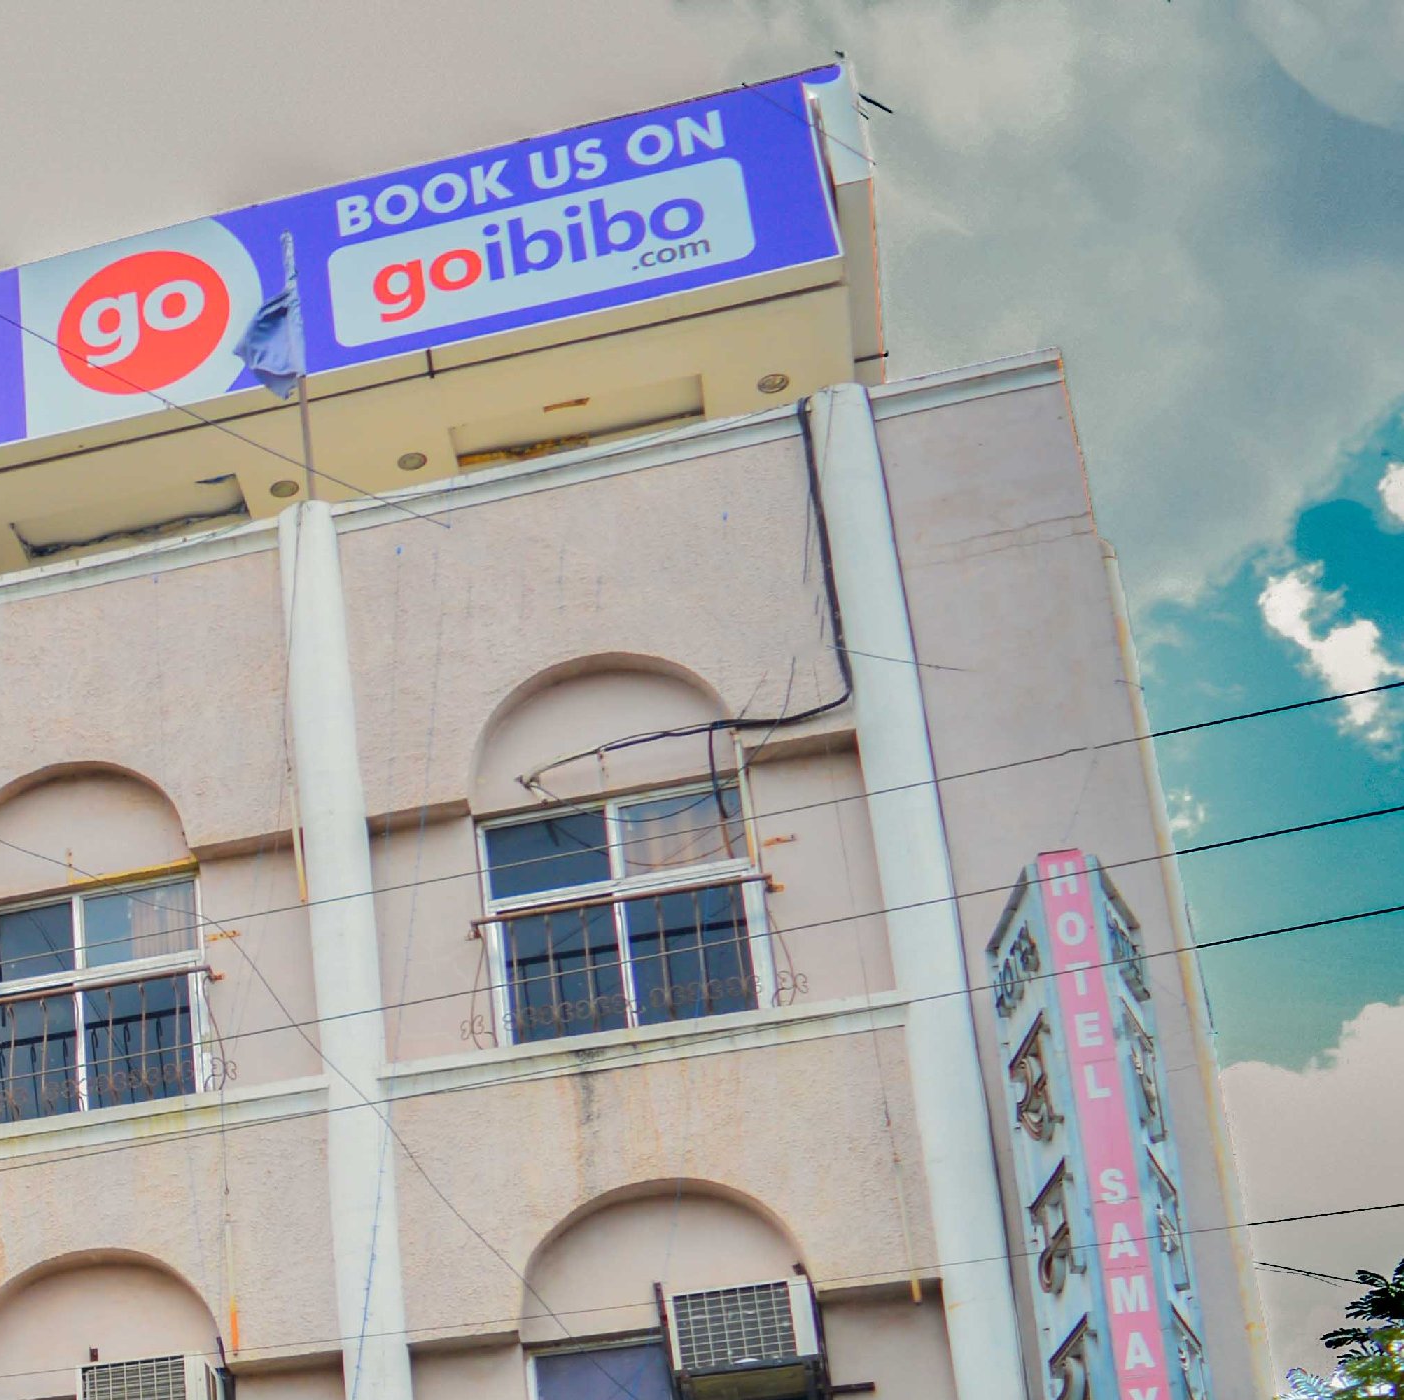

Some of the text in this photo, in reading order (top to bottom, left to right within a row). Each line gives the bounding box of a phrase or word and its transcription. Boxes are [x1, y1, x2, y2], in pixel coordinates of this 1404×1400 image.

[335, 108, 727, 239] BOOK US ON
[371, 194, 705, 323] goibibo
[631, 235, 712, 272] .com
[79, 269, 204, 370] go
[1047, 860, 1114, 1100] HOTEL
